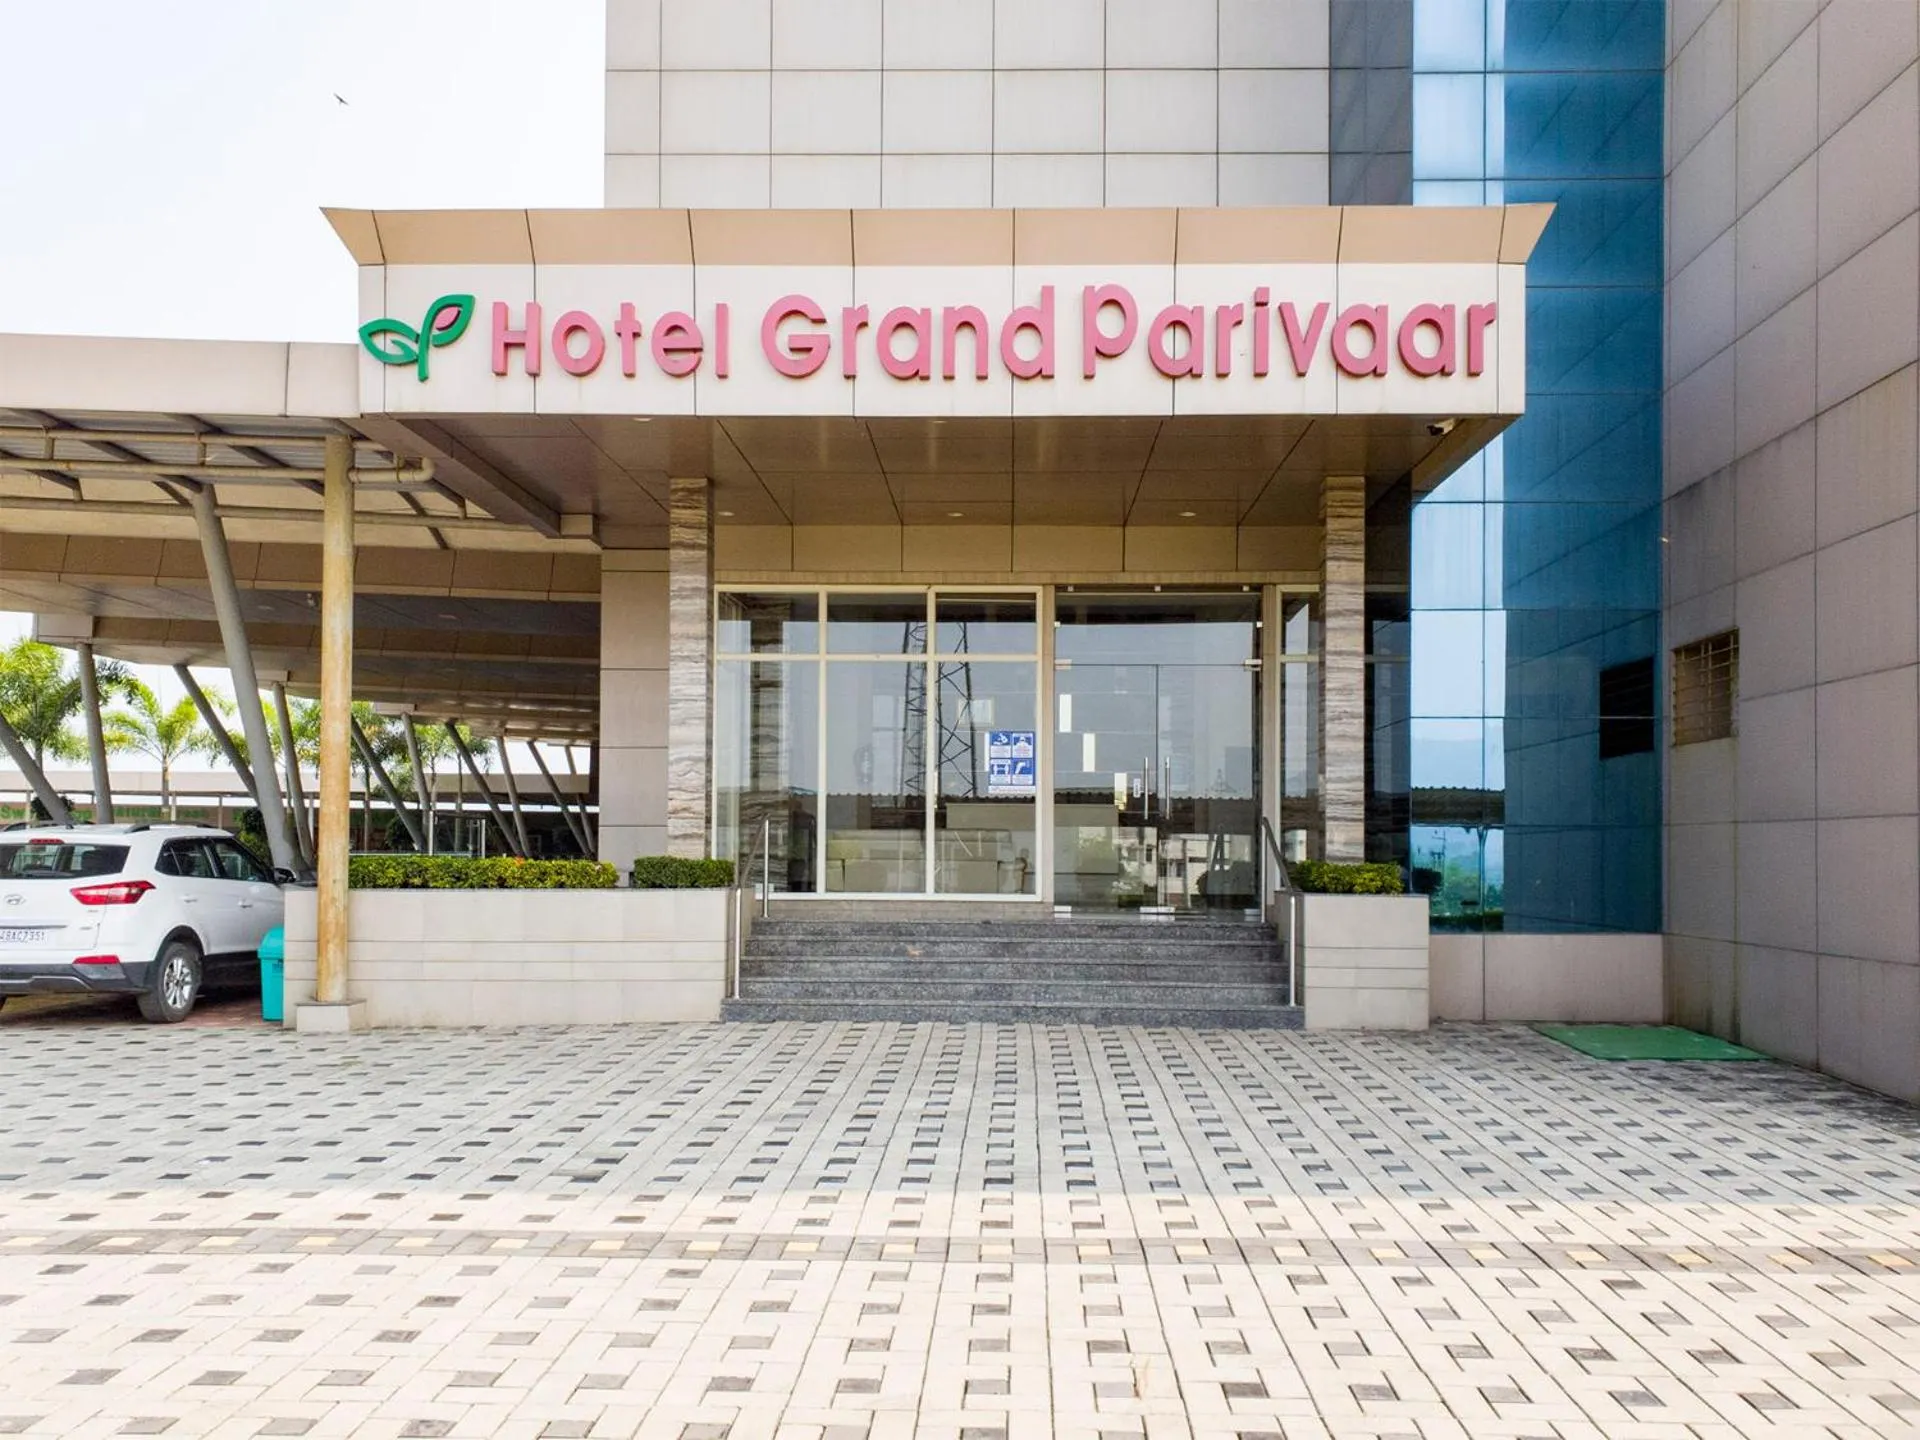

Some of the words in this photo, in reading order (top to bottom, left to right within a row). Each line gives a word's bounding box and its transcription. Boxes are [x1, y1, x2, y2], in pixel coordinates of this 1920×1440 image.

[491, 301, 730, 380] Hotel
[760, 286, 1055, 380] Grand
[1083, 284, 1498, 379] Parivaar
